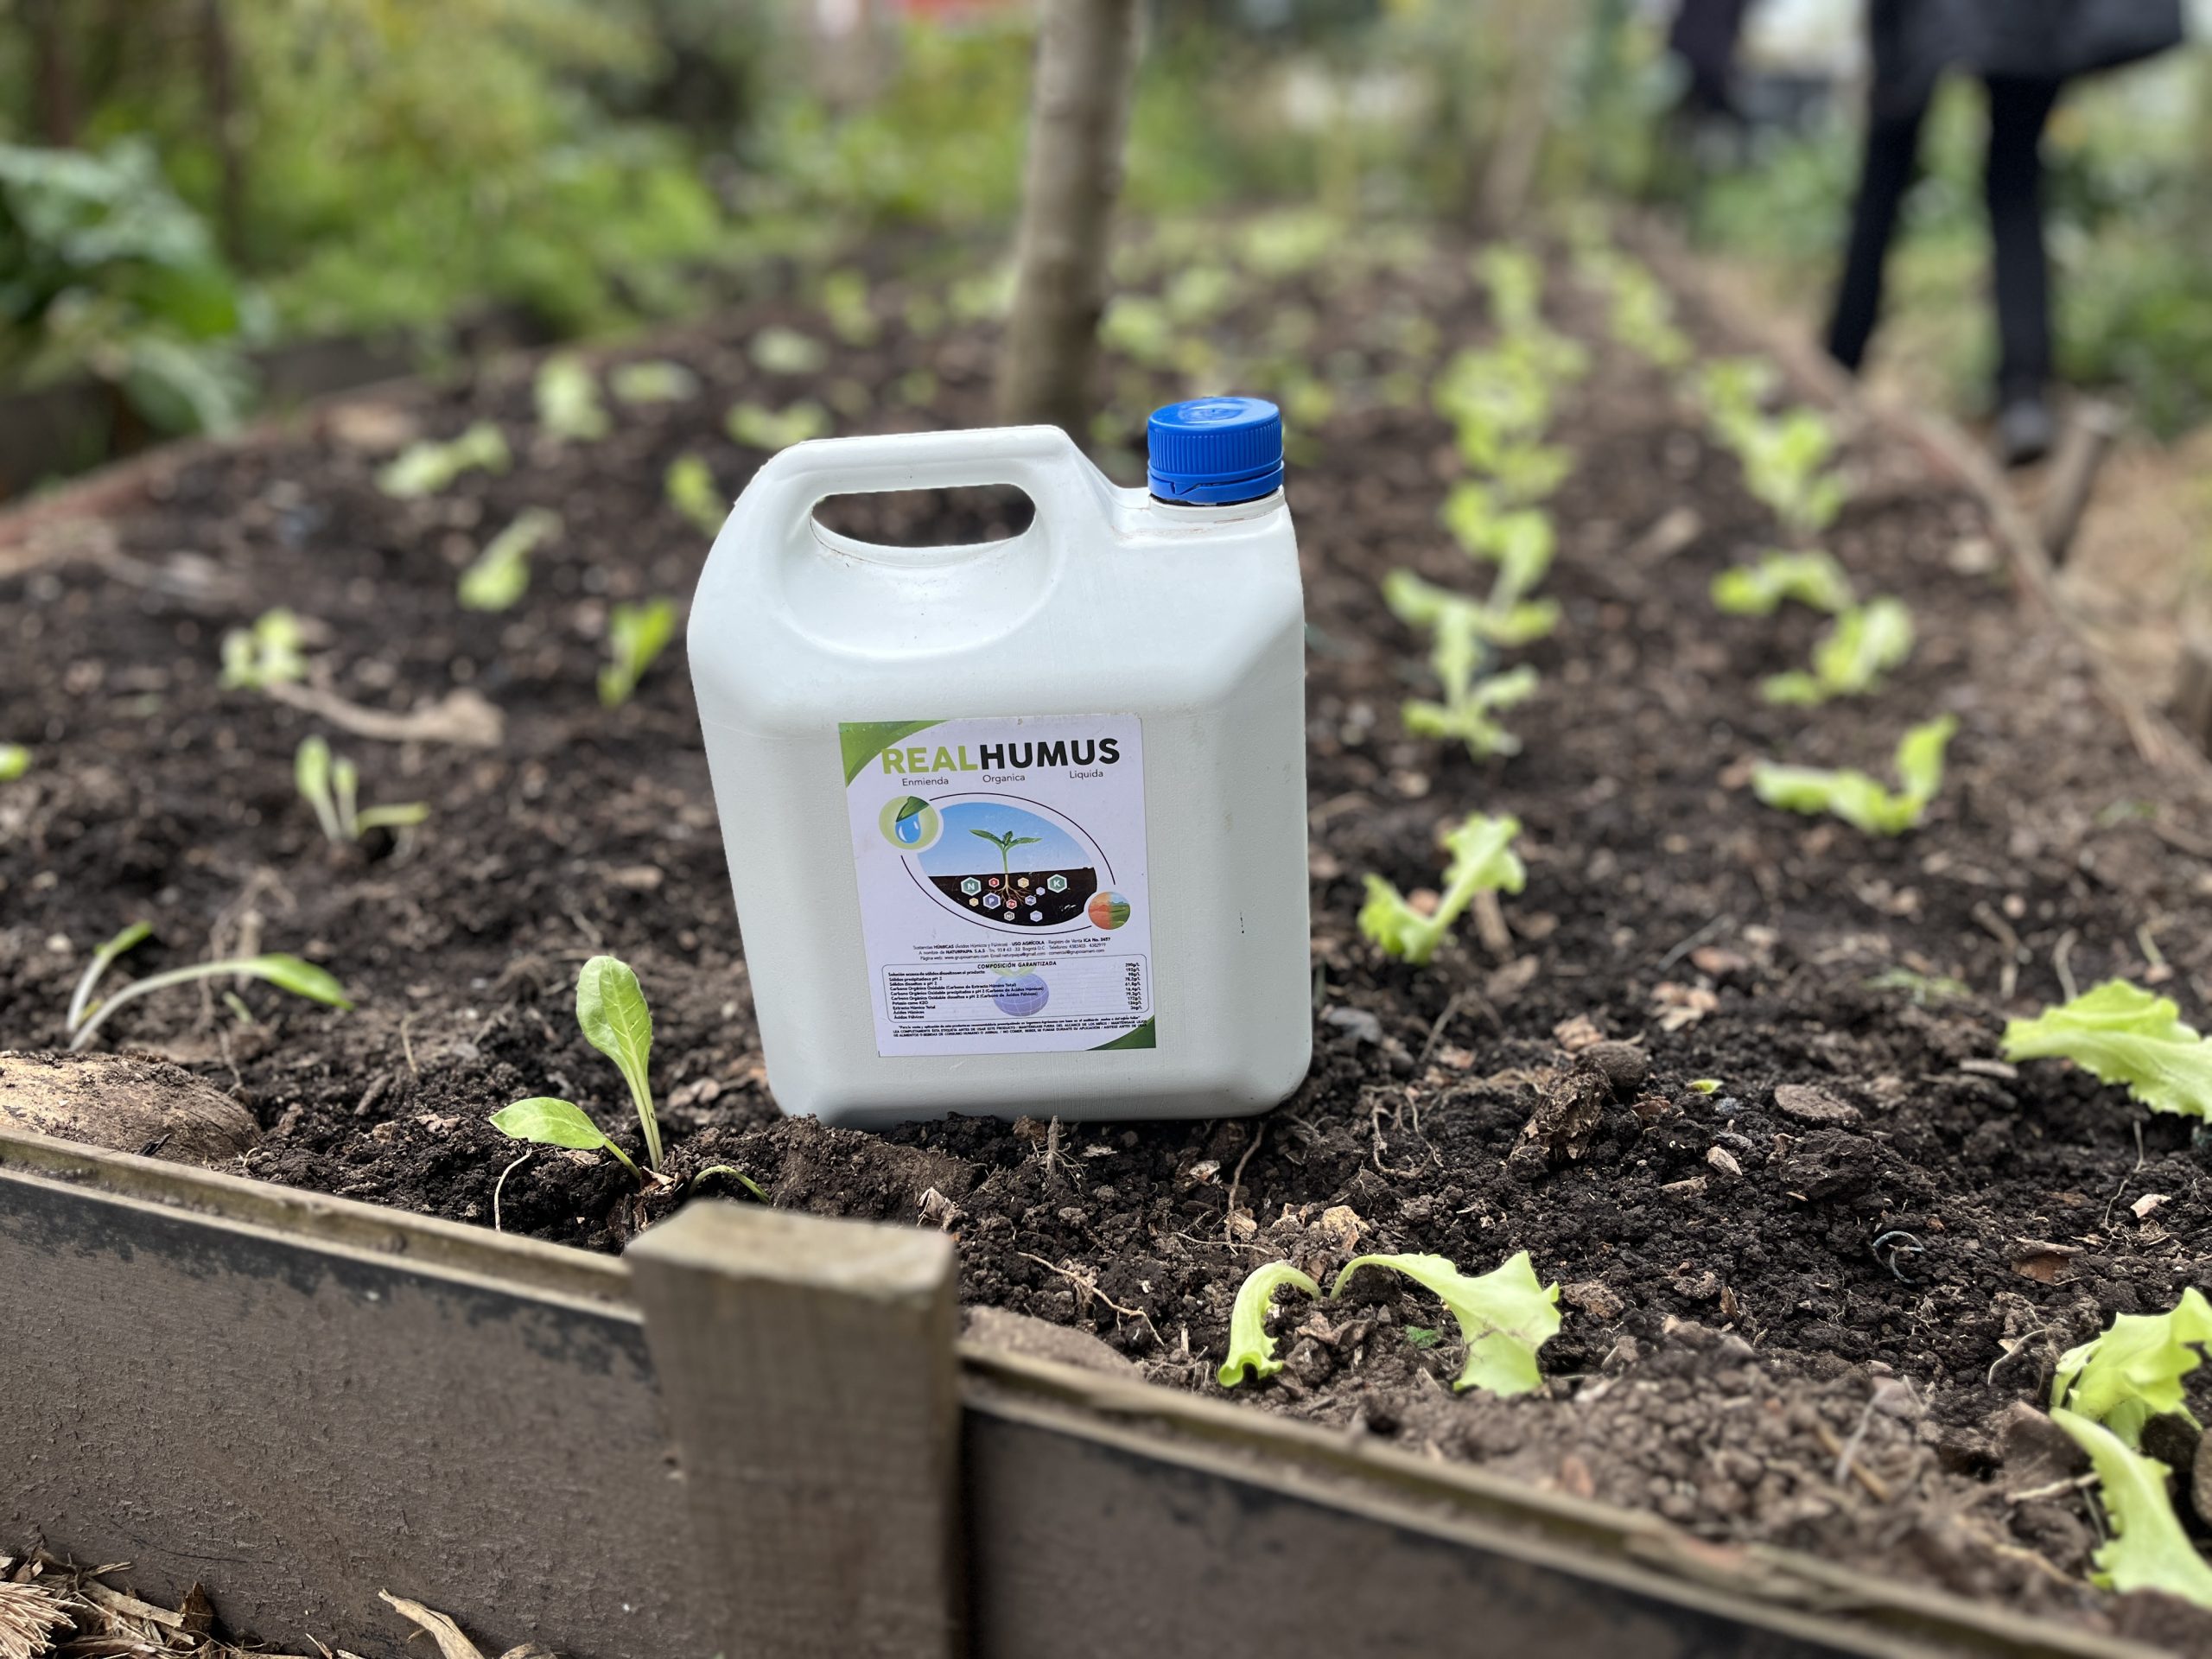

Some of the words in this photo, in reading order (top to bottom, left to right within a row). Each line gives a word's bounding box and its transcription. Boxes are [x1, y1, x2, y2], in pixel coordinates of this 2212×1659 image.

[881, 738, 1120, 775] REALHUMUS
[902, 776, 949, 786] Enmienda
[982, 773, 1026, 784] Organica
[1069, 769, 1103, 779] Liquida
